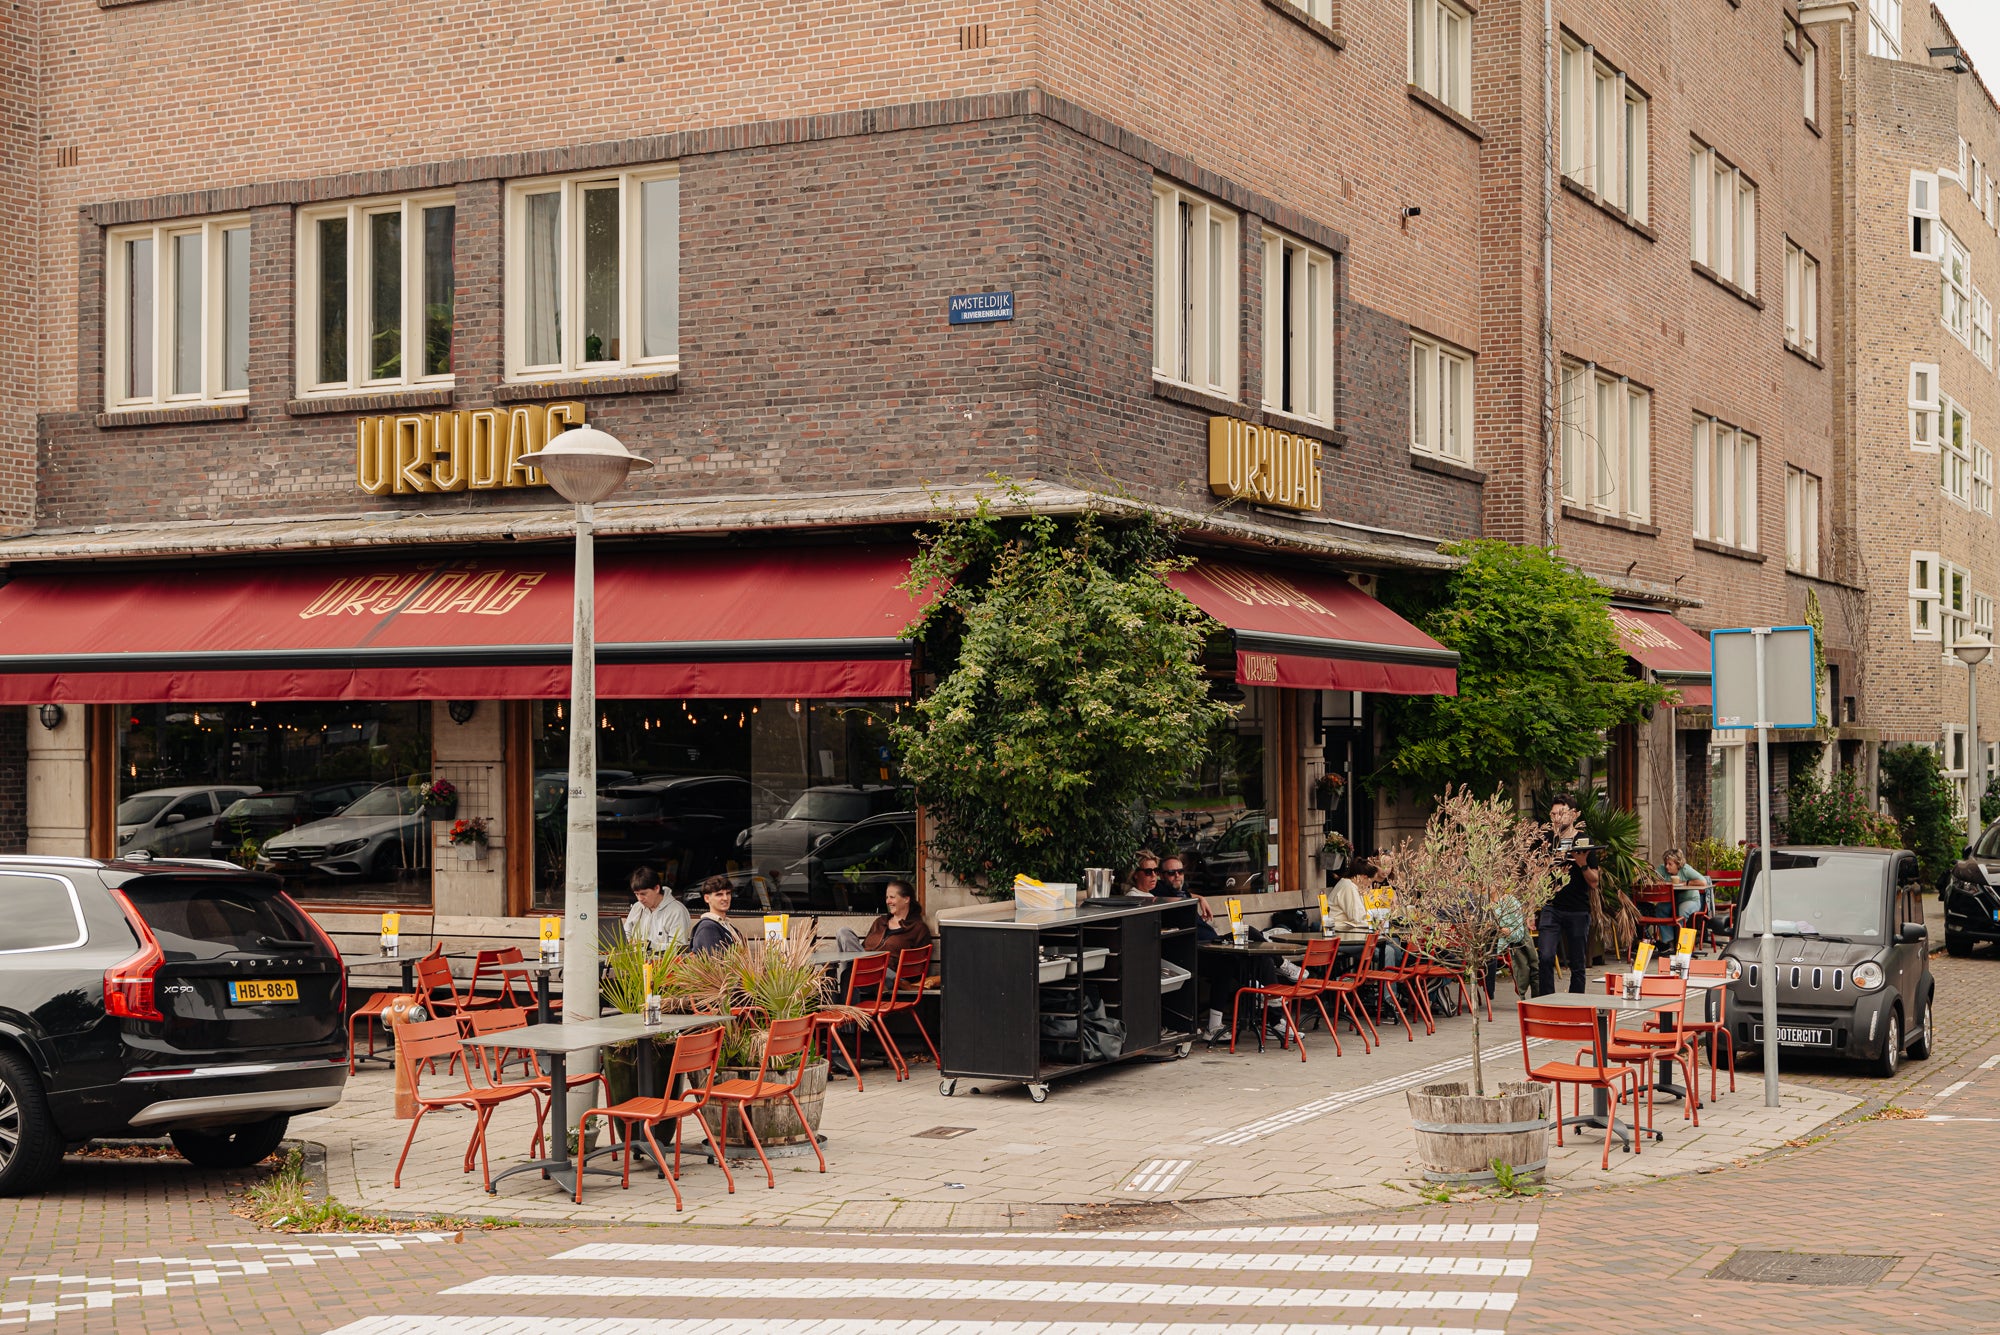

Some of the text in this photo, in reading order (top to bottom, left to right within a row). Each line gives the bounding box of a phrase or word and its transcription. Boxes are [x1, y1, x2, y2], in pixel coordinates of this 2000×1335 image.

[951, 295, 1010, 309] AMSTELDIJK
[963, 308, 1010, 319] RIVIERENBUURT
[239, 983, 294, 999] HBL-88-D
[1776, 1028, 1823, 1043] OOTERCITY
